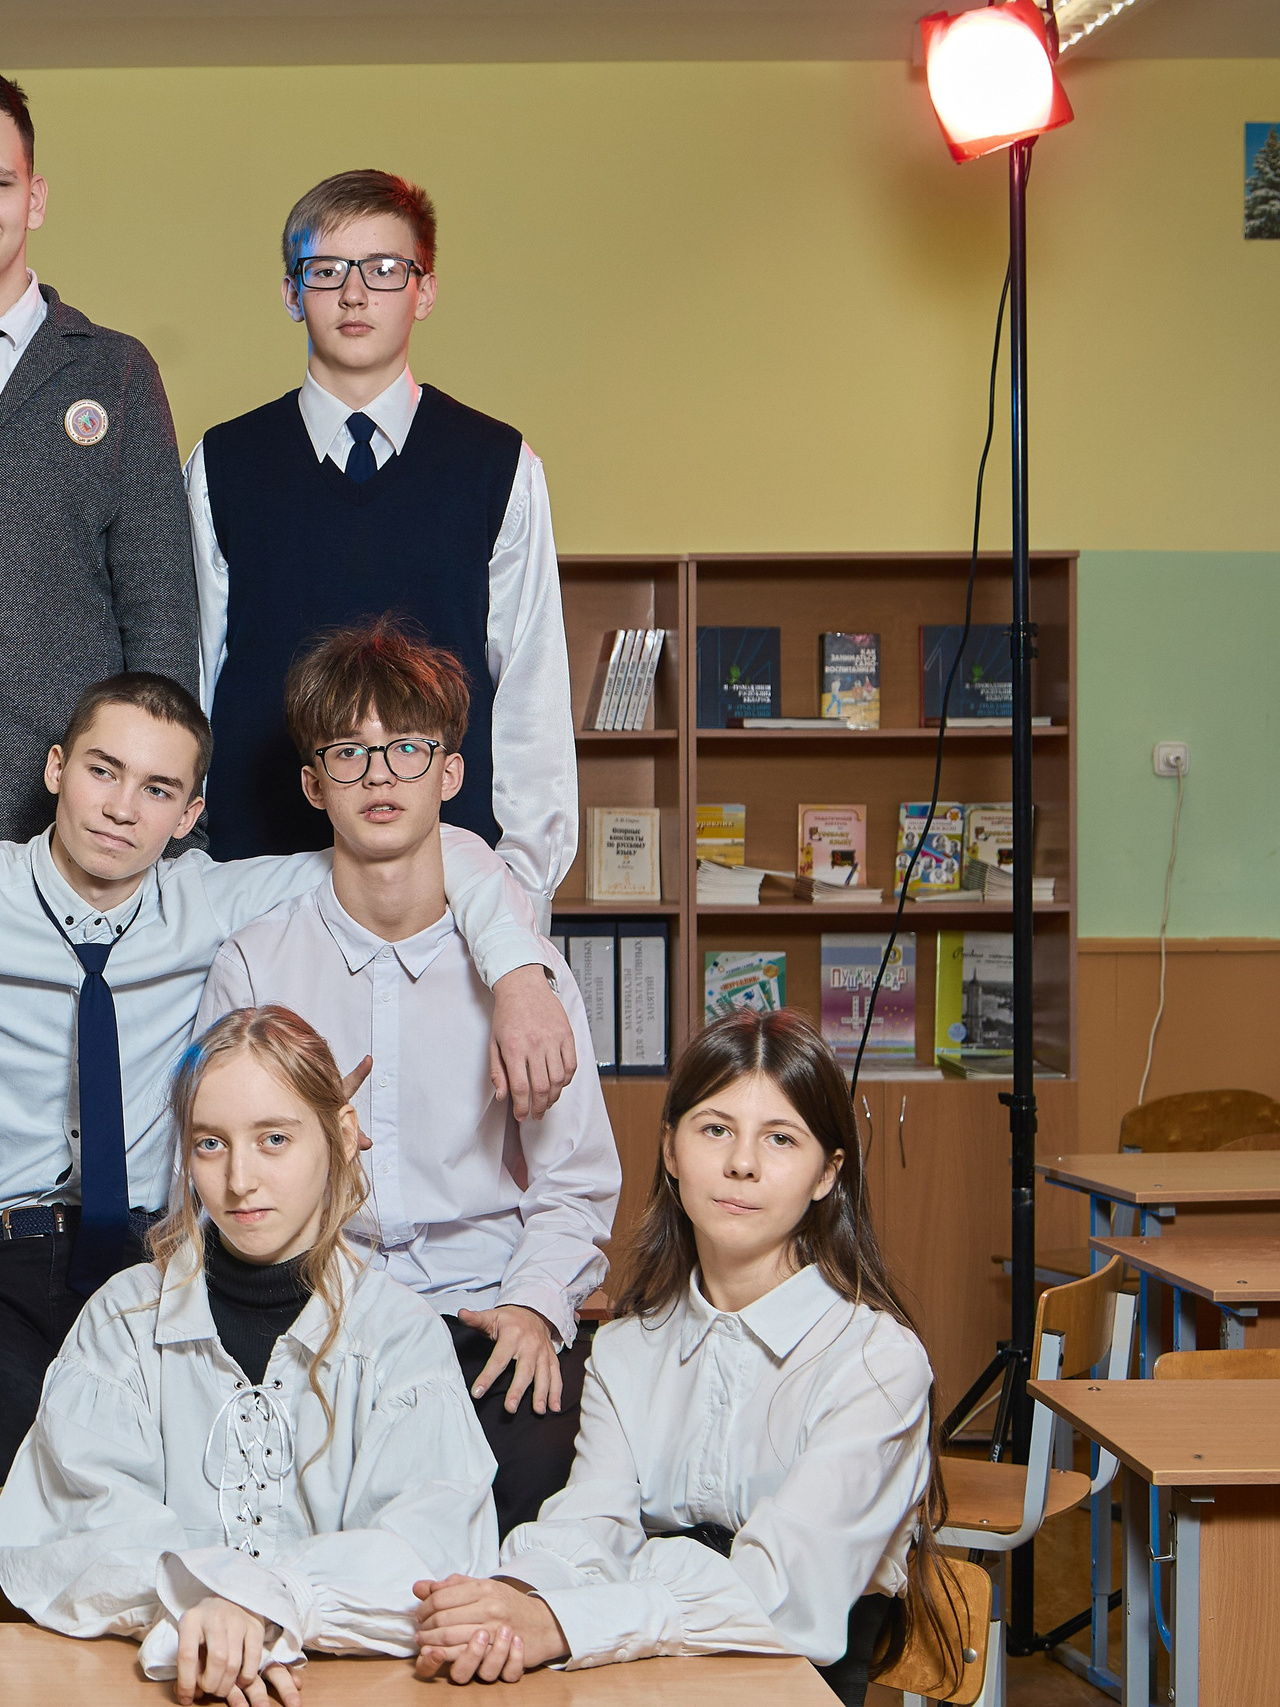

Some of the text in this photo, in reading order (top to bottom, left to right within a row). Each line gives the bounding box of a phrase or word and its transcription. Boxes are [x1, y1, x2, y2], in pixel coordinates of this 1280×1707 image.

[624, 968, 632, 1031] МАТЕРИАЛЫ
[635, 940, 645, 1059] ДЛЯ ФАКУЛЬТАТИВНЫХ
[646, 976, 655, 1021] ЗАНЯТИЙ
[832, 967, 907, 989] ПУШКИНРАД
